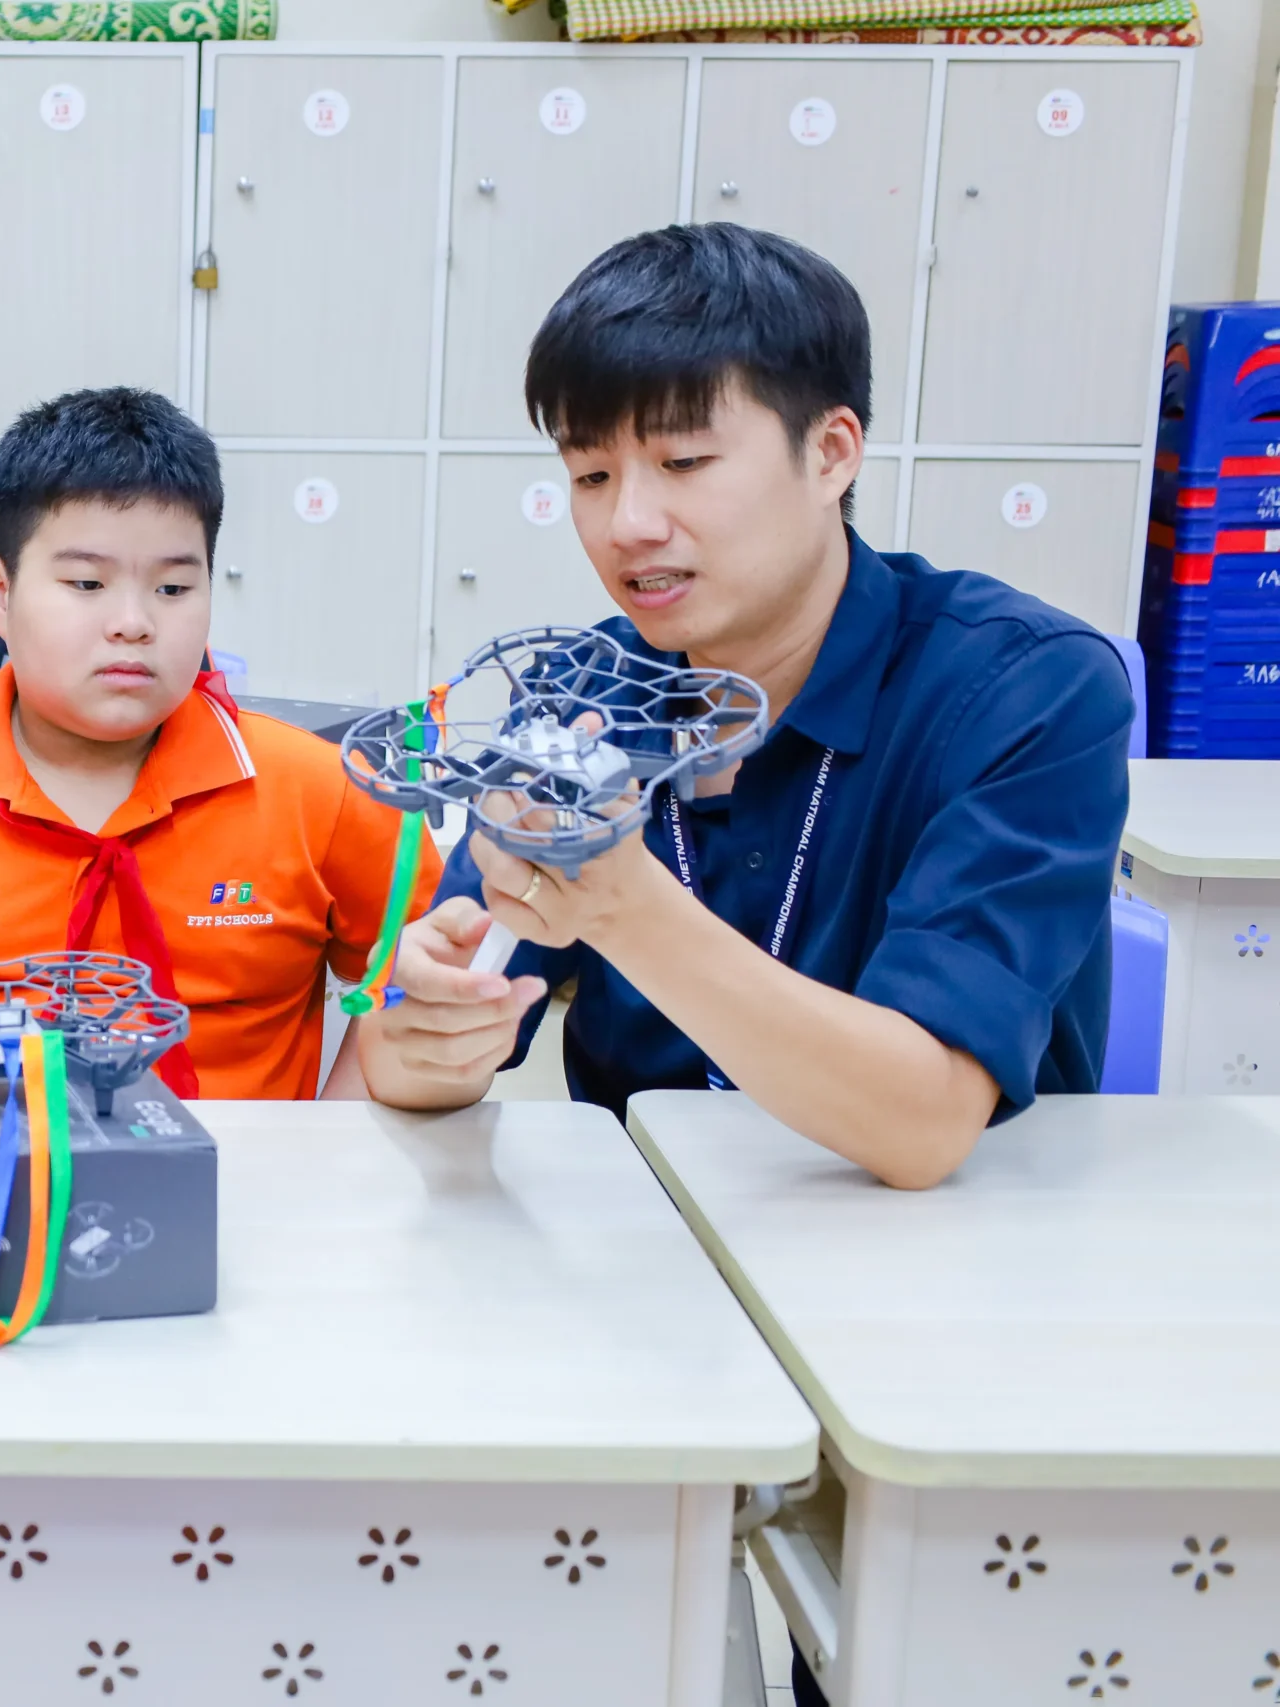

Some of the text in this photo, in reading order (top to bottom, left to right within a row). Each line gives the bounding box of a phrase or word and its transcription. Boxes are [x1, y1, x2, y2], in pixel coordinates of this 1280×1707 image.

[797, 785, 824, 853] NATIONAL
[672, 824, 691, 884] VIETNAM
[187, 913, 274, 927] FPT SCHOOLS
[211, 883, 252, 903] FPT
[770, 854, 805, 957] CHAMPIONSHIP
